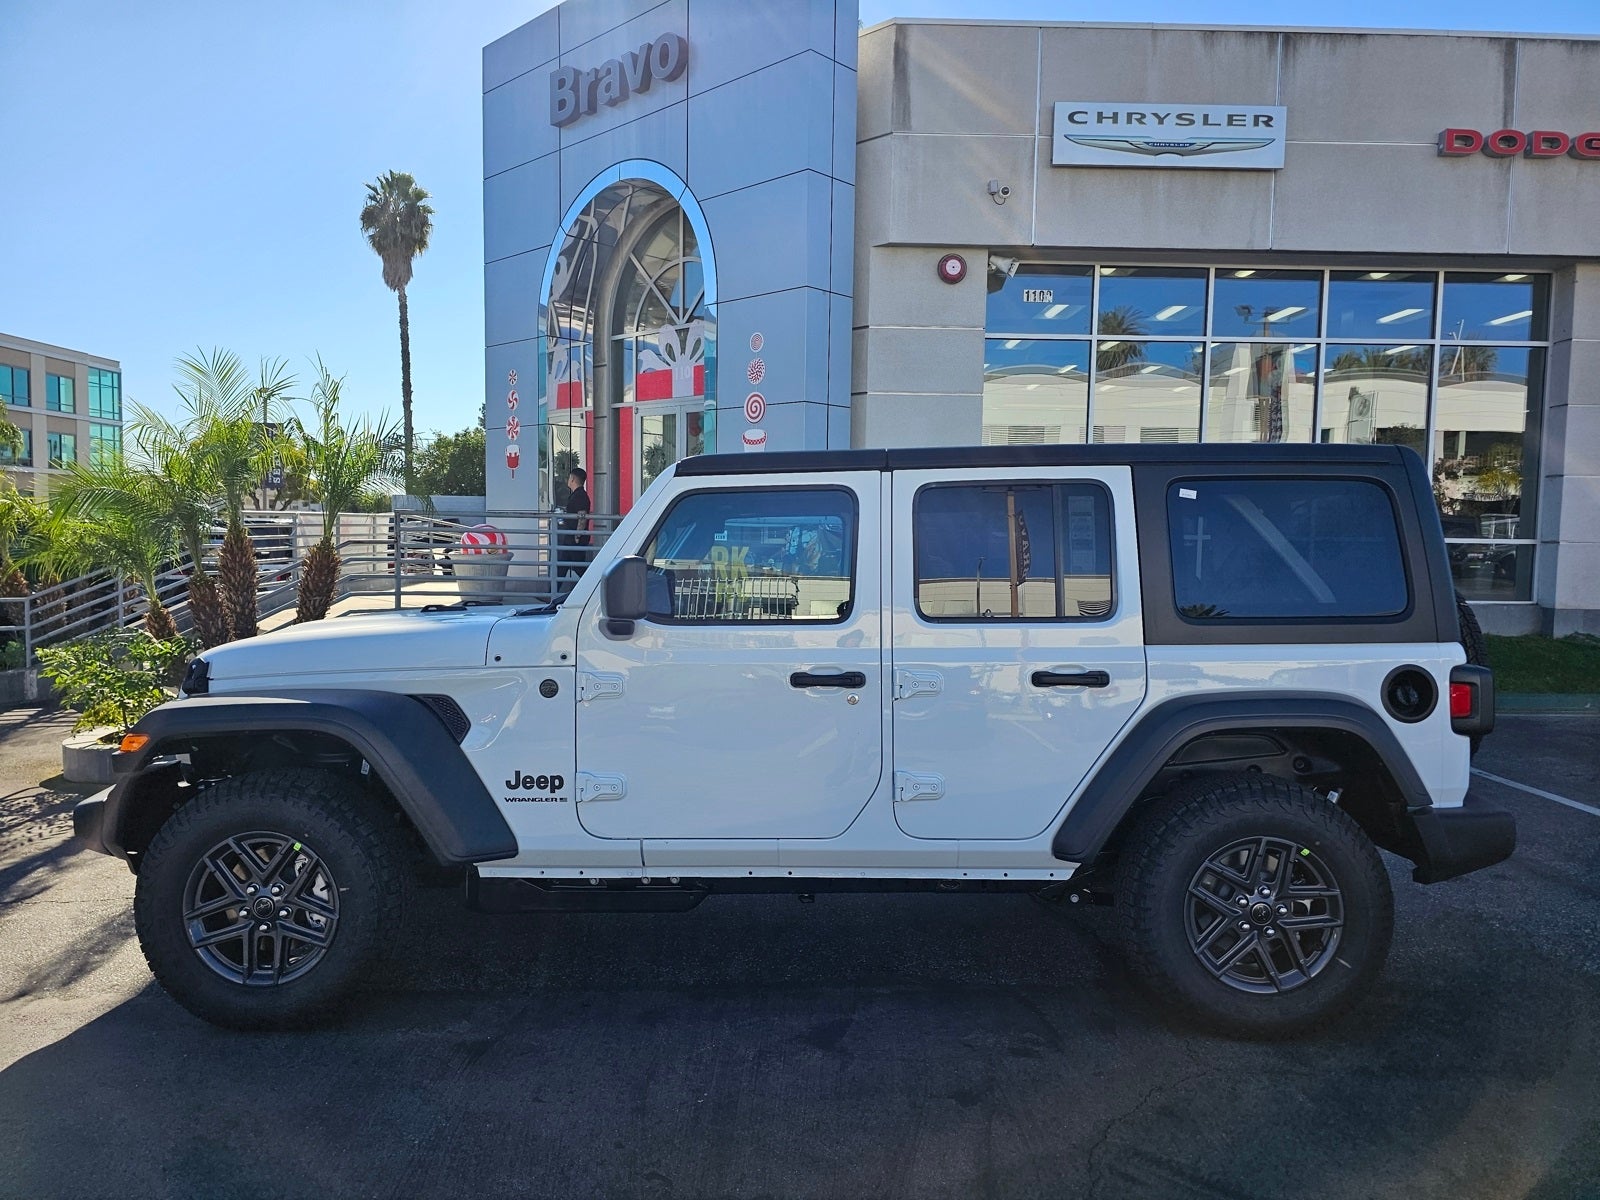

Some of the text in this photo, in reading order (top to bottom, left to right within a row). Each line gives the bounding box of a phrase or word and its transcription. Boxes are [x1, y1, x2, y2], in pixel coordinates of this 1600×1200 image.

[550, 31, 688, 128] Bravo
[1067, 110, 1274, 128] CHRYSLER
[505, 770, 564, 793] Jeep
